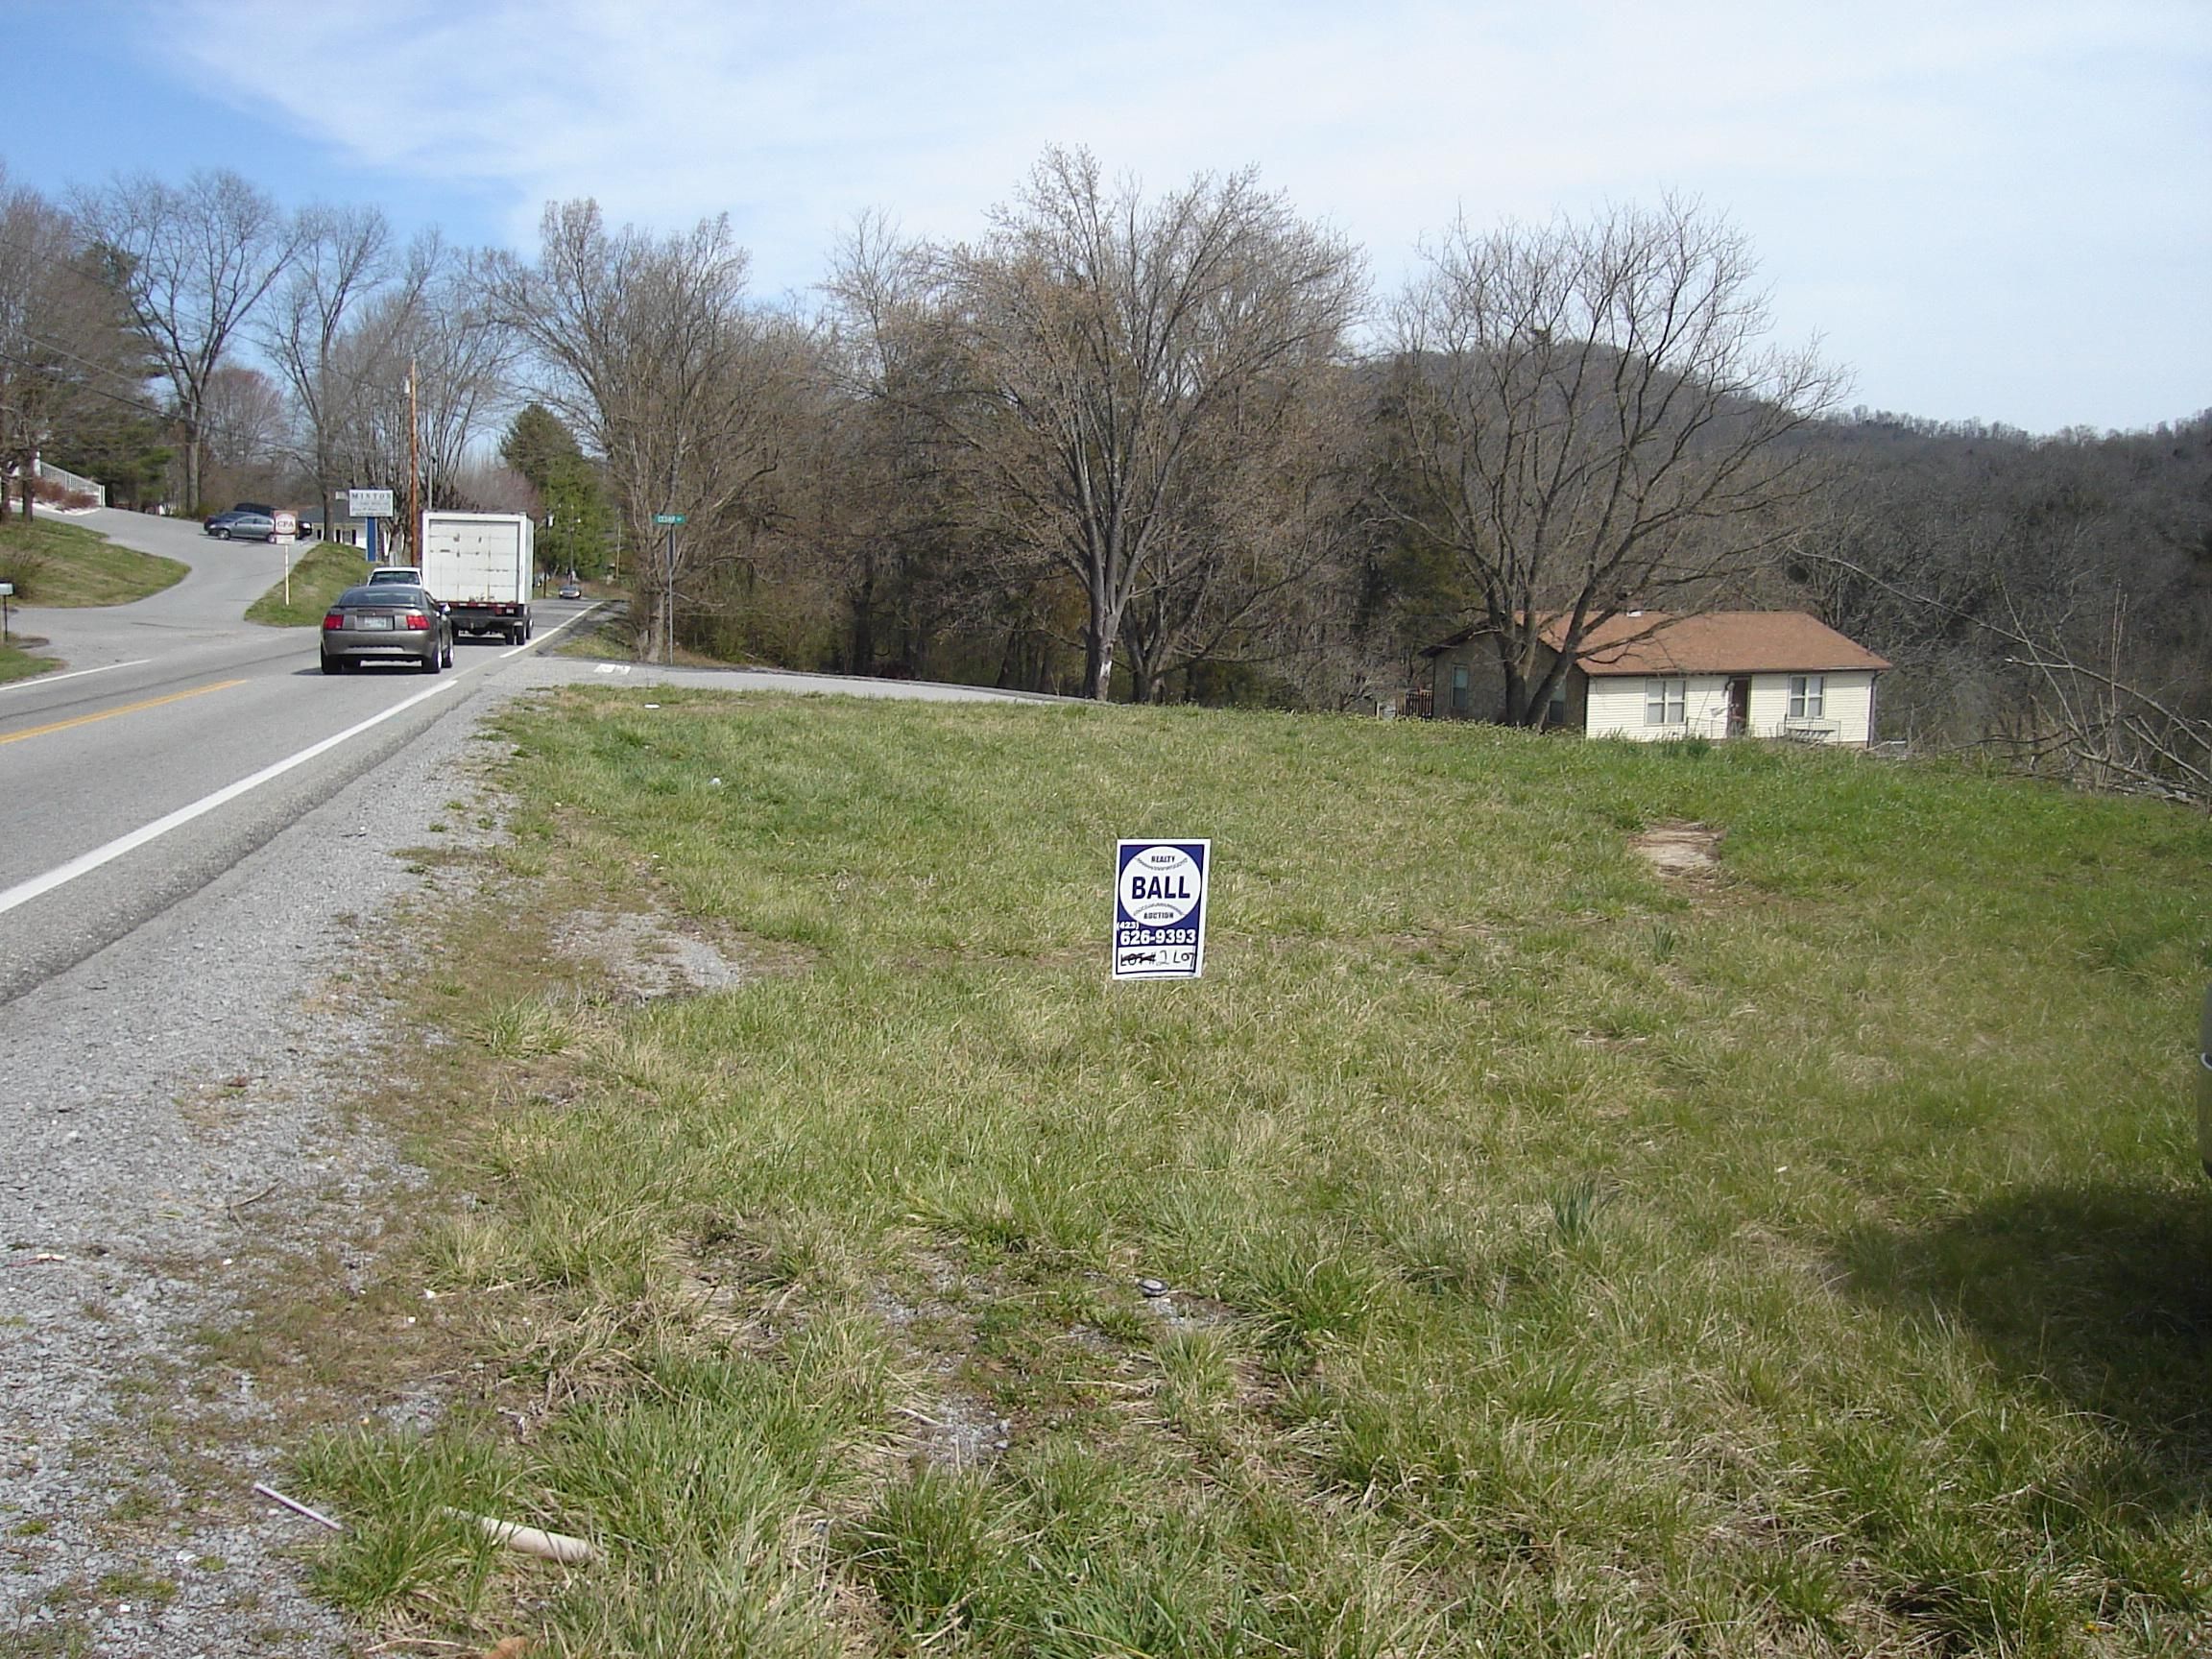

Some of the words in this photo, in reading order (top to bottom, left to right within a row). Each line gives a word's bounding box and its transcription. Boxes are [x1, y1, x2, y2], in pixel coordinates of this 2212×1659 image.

[1151, 854, 1176, 863] REALTY
[1131, 876, 1190, 900] BALL
[1117, 922, 1140, 930] (423)
[1119, 929, 1196, 946] 626-9393
